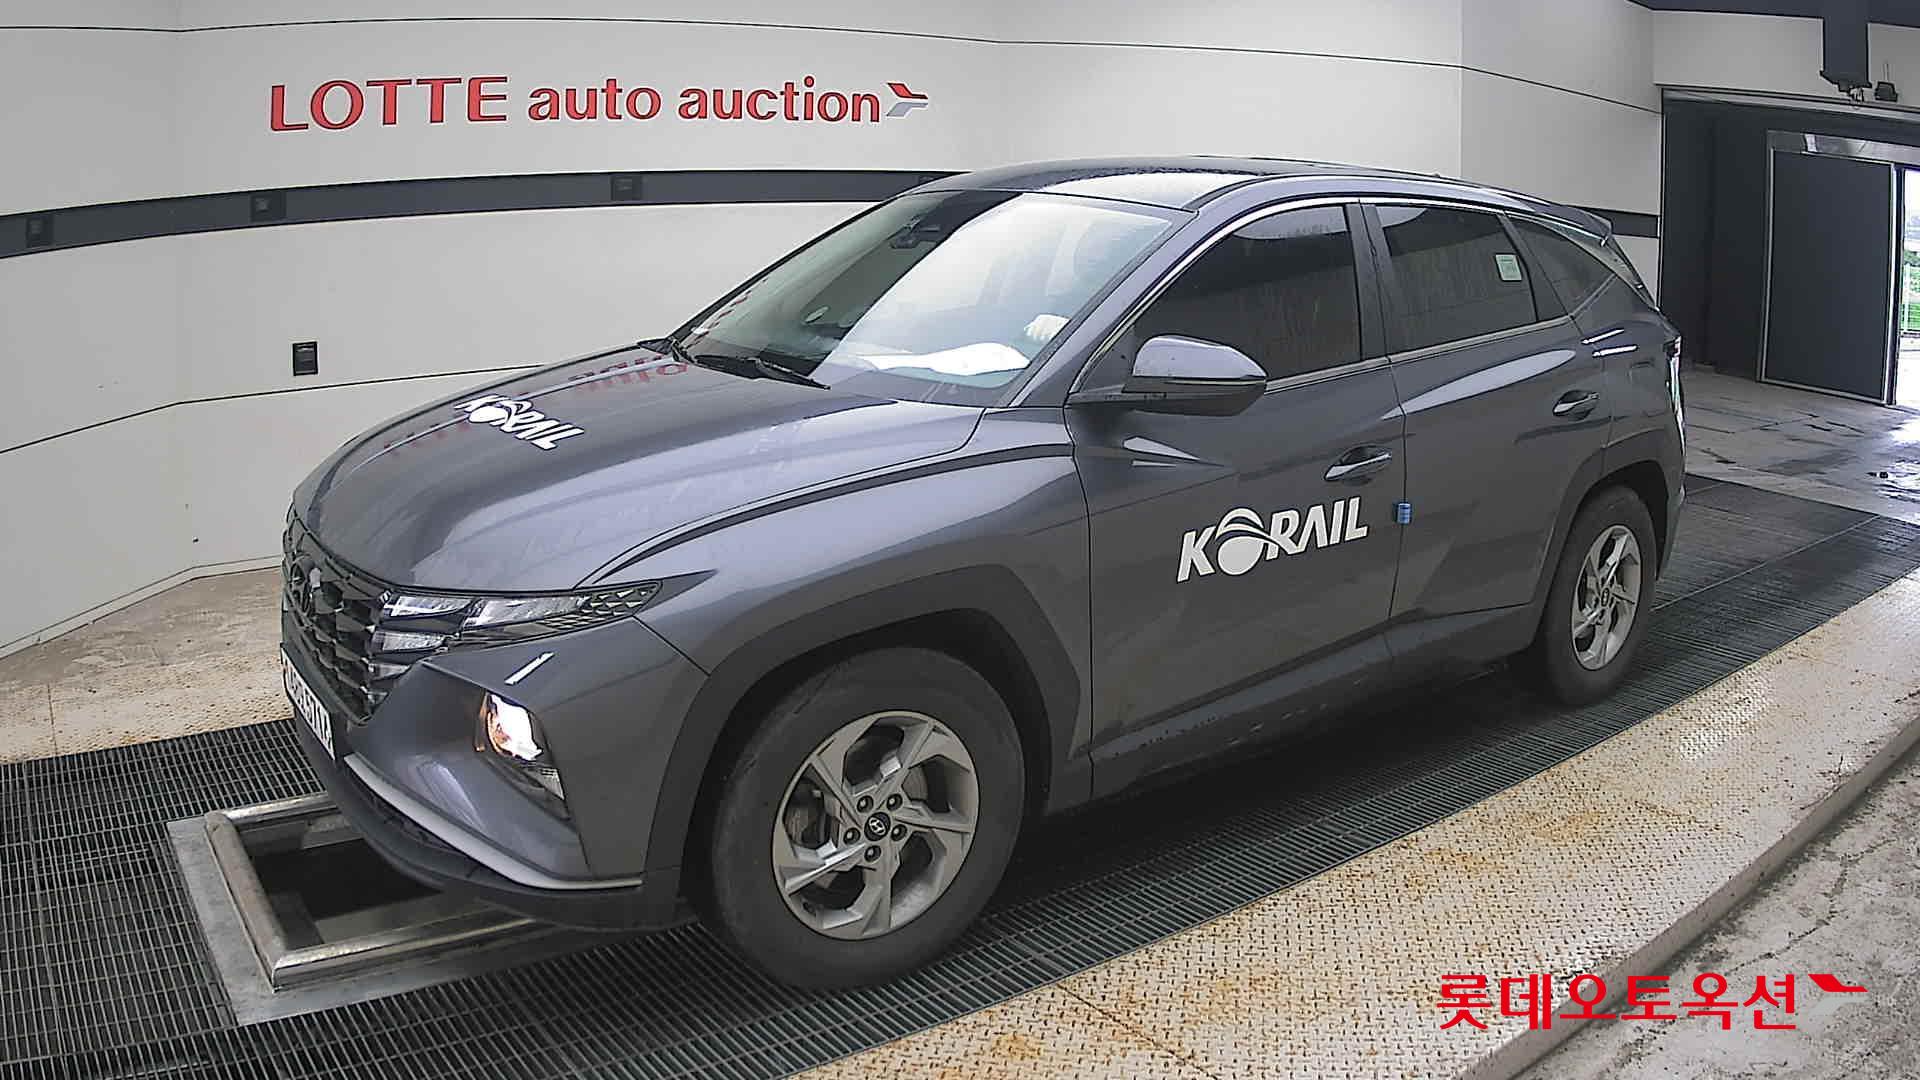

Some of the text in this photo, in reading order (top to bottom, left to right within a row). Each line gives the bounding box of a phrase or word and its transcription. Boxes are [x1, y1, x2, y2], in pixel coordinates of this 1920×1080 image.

[270, 76, 881, 131] LOTTE auto auction
[454, 393, 585, 450] KORAIL
[1177, 496, 1368, 583] KORAIL
